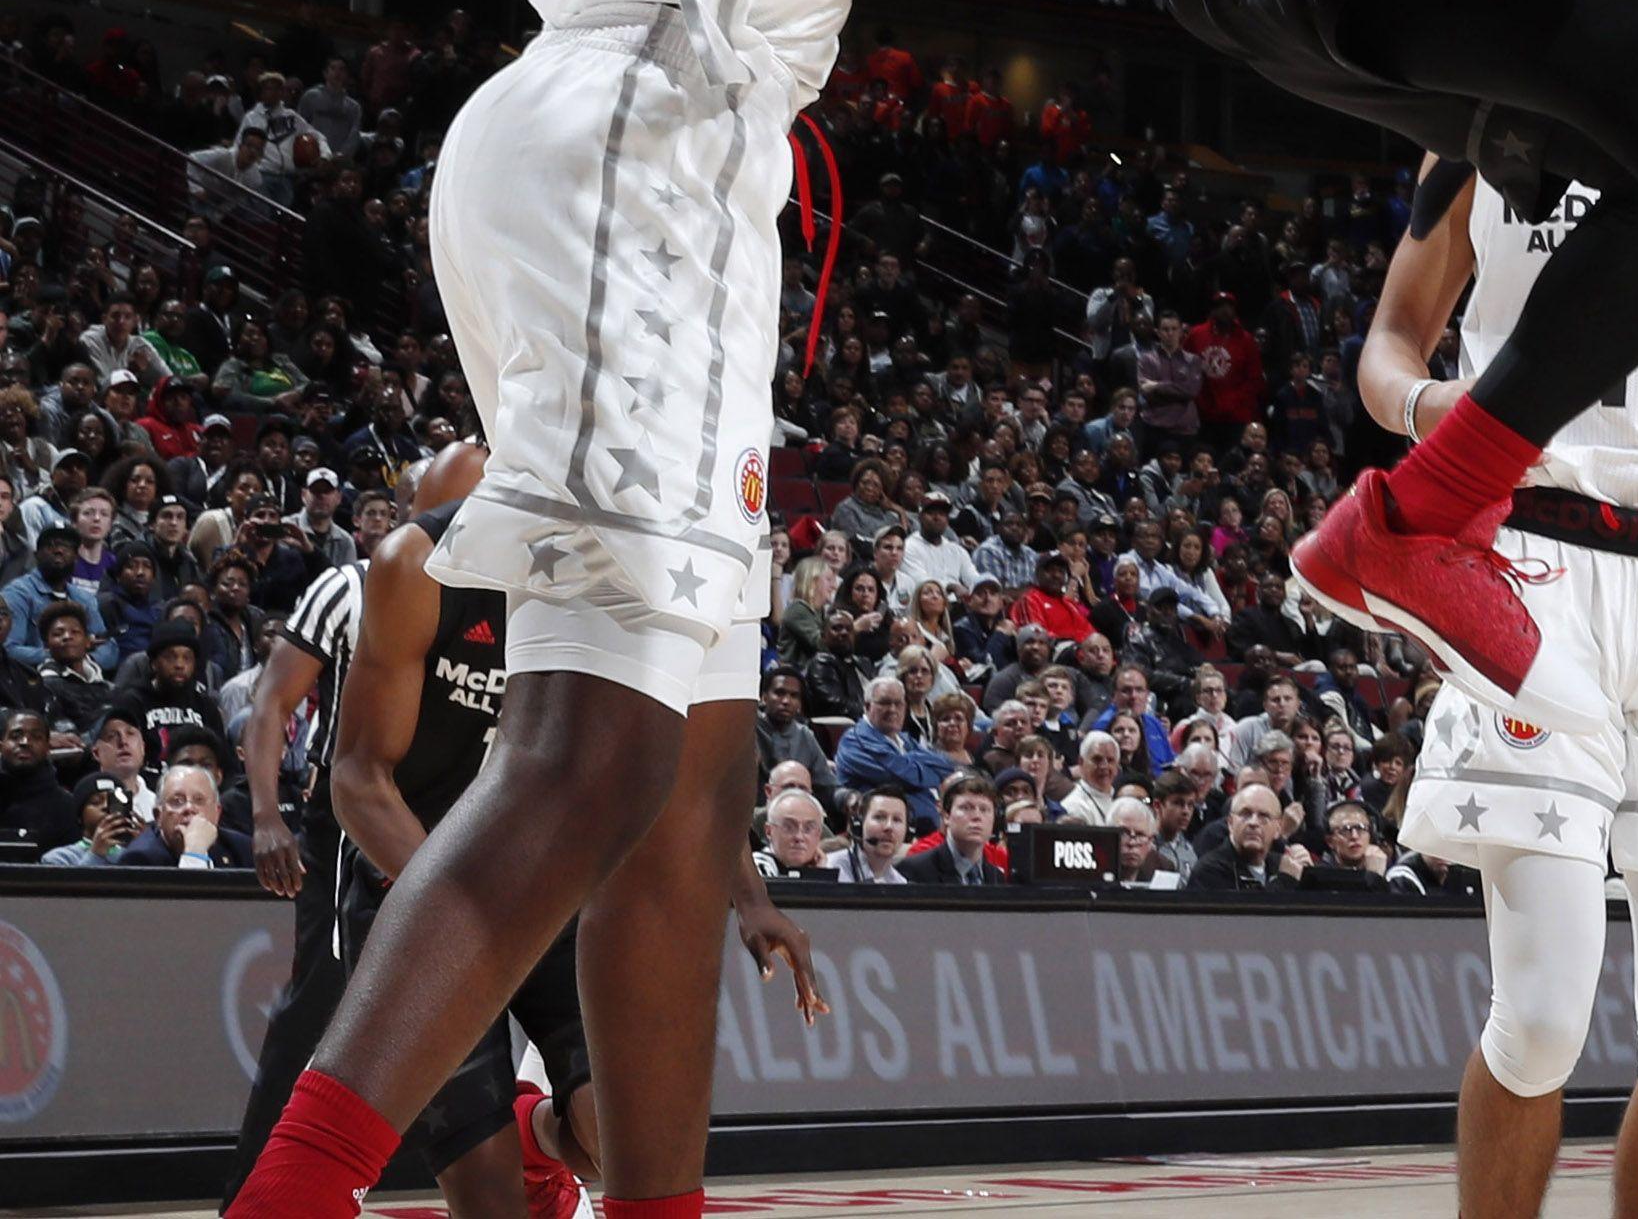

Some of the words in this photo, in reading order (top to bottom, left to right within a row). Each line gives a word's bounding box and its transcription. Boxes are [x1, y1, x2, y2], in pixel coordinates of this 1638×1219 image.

[448, 687, 496, 716] ALL
[1053, 840, 1097, 871] POSS.
[932, 949, 1079, 1079] ALL
[1092, 949, 1450, 1076] AMERICAN
